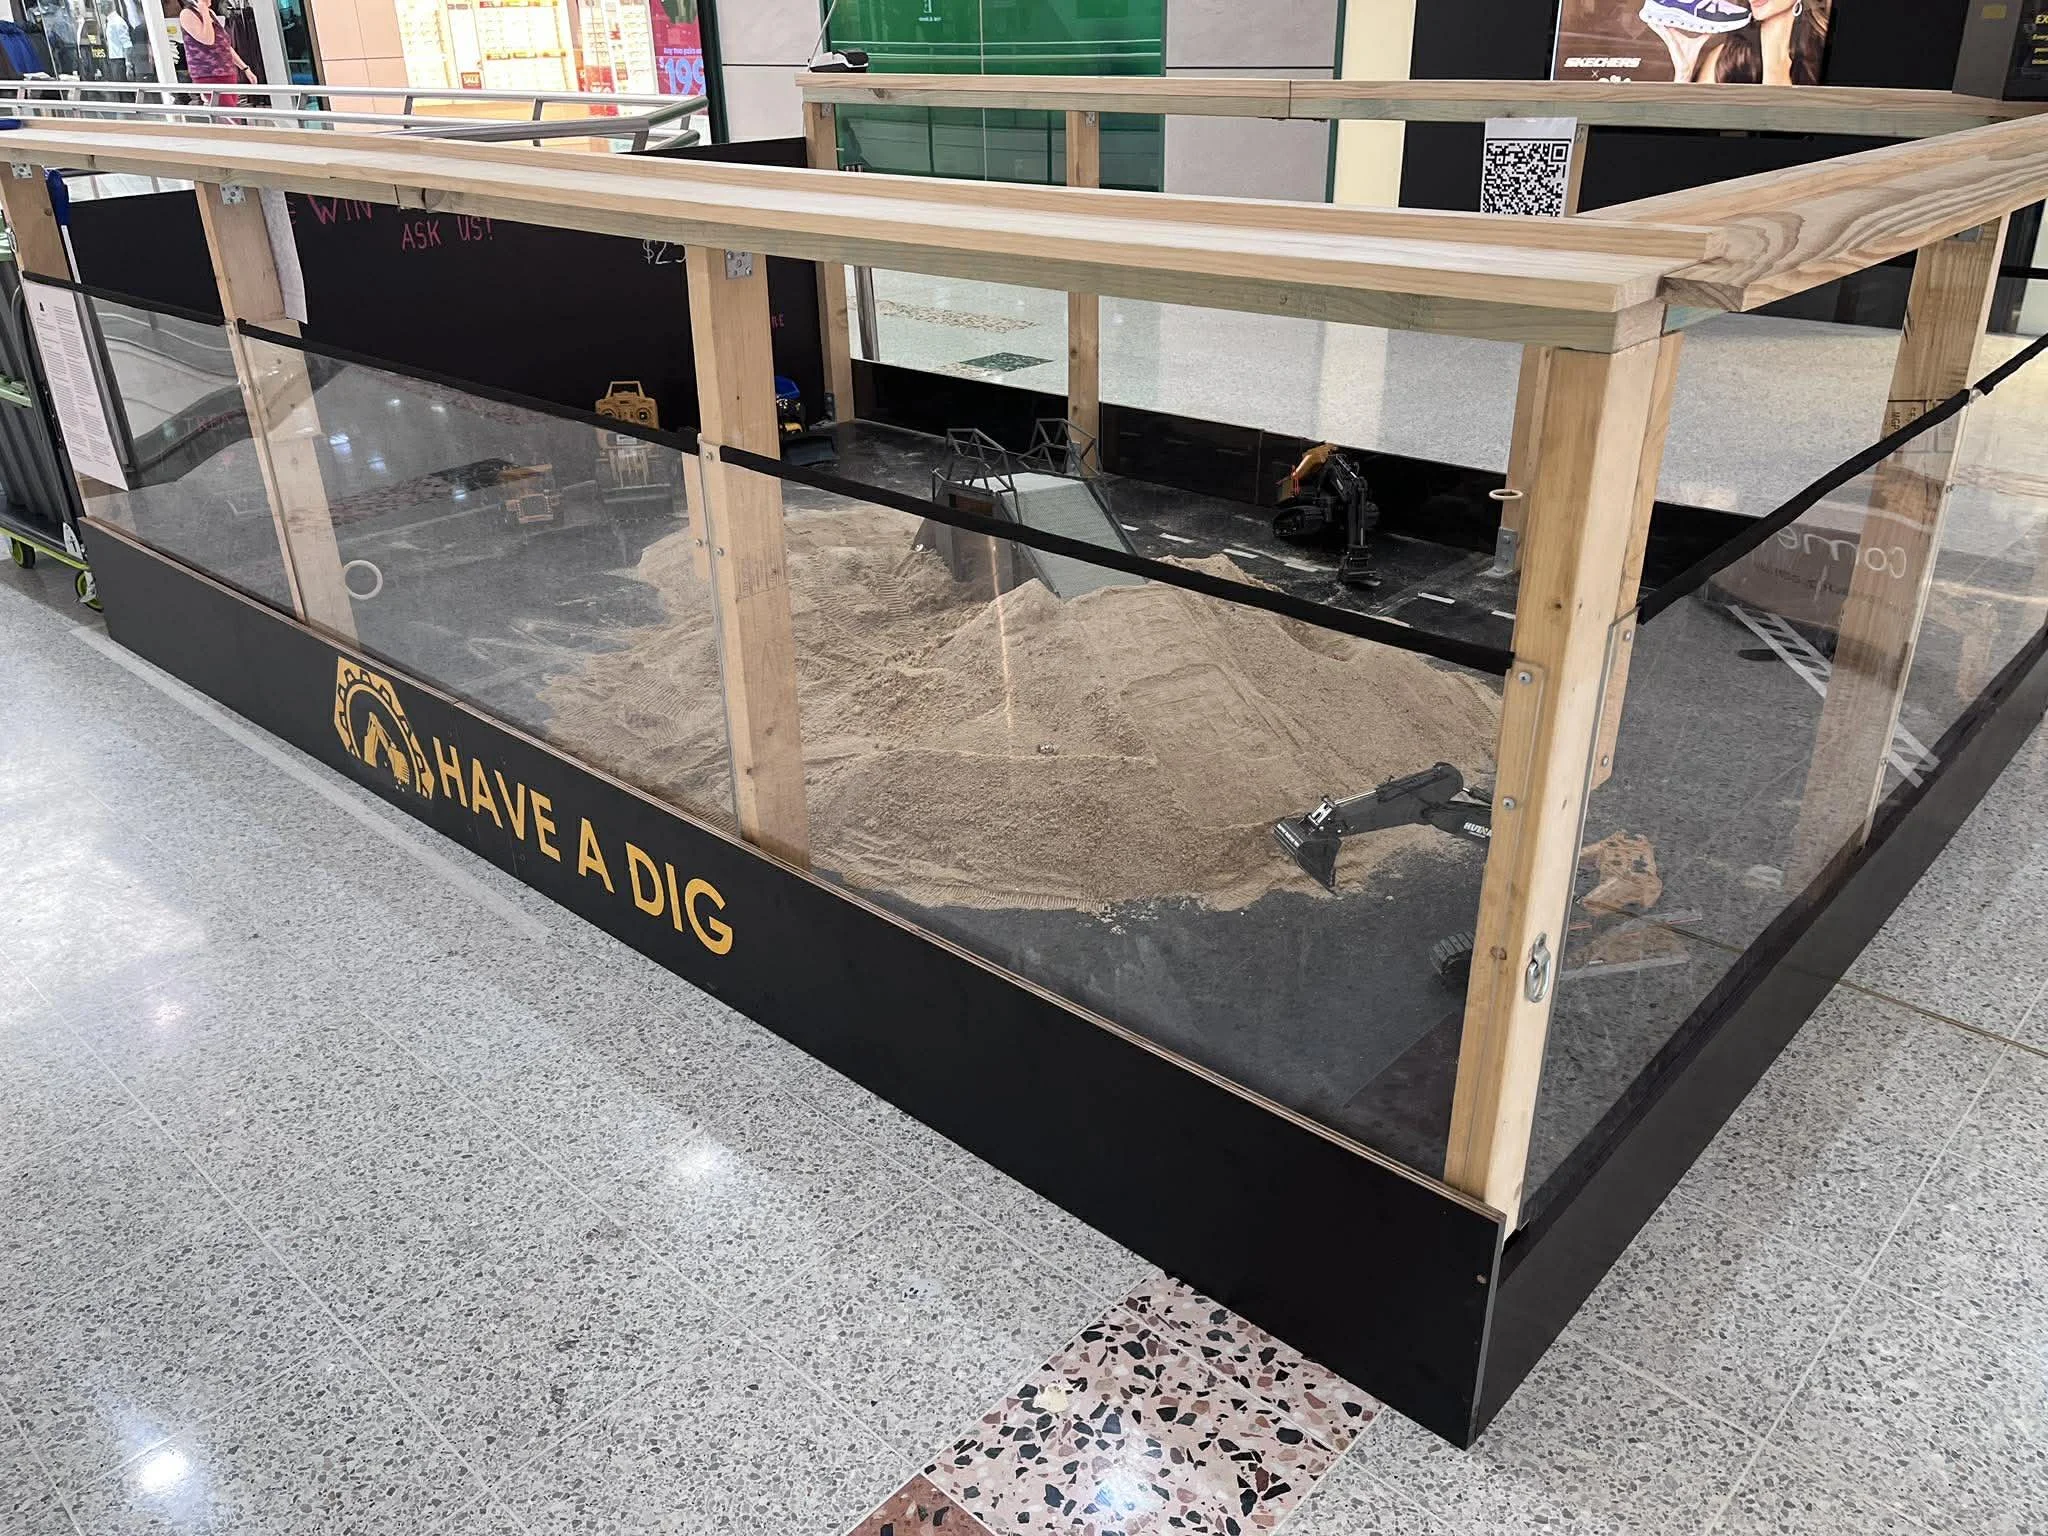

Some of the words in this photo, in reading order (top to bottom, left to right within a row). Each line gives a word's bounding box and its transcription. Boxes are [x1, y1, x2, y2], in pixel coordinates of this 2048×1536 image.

[1563, 57, 1642, 68] SKECHERS
[307, 193, 374, 225] WIN
[401, 218, 443, 251] ASK
[456, 214, 495, 242] US!
[432, 735, 561, 862] HAVE
[577, 816, 615, 893] A
[625, 840, 734, 956] DIG
